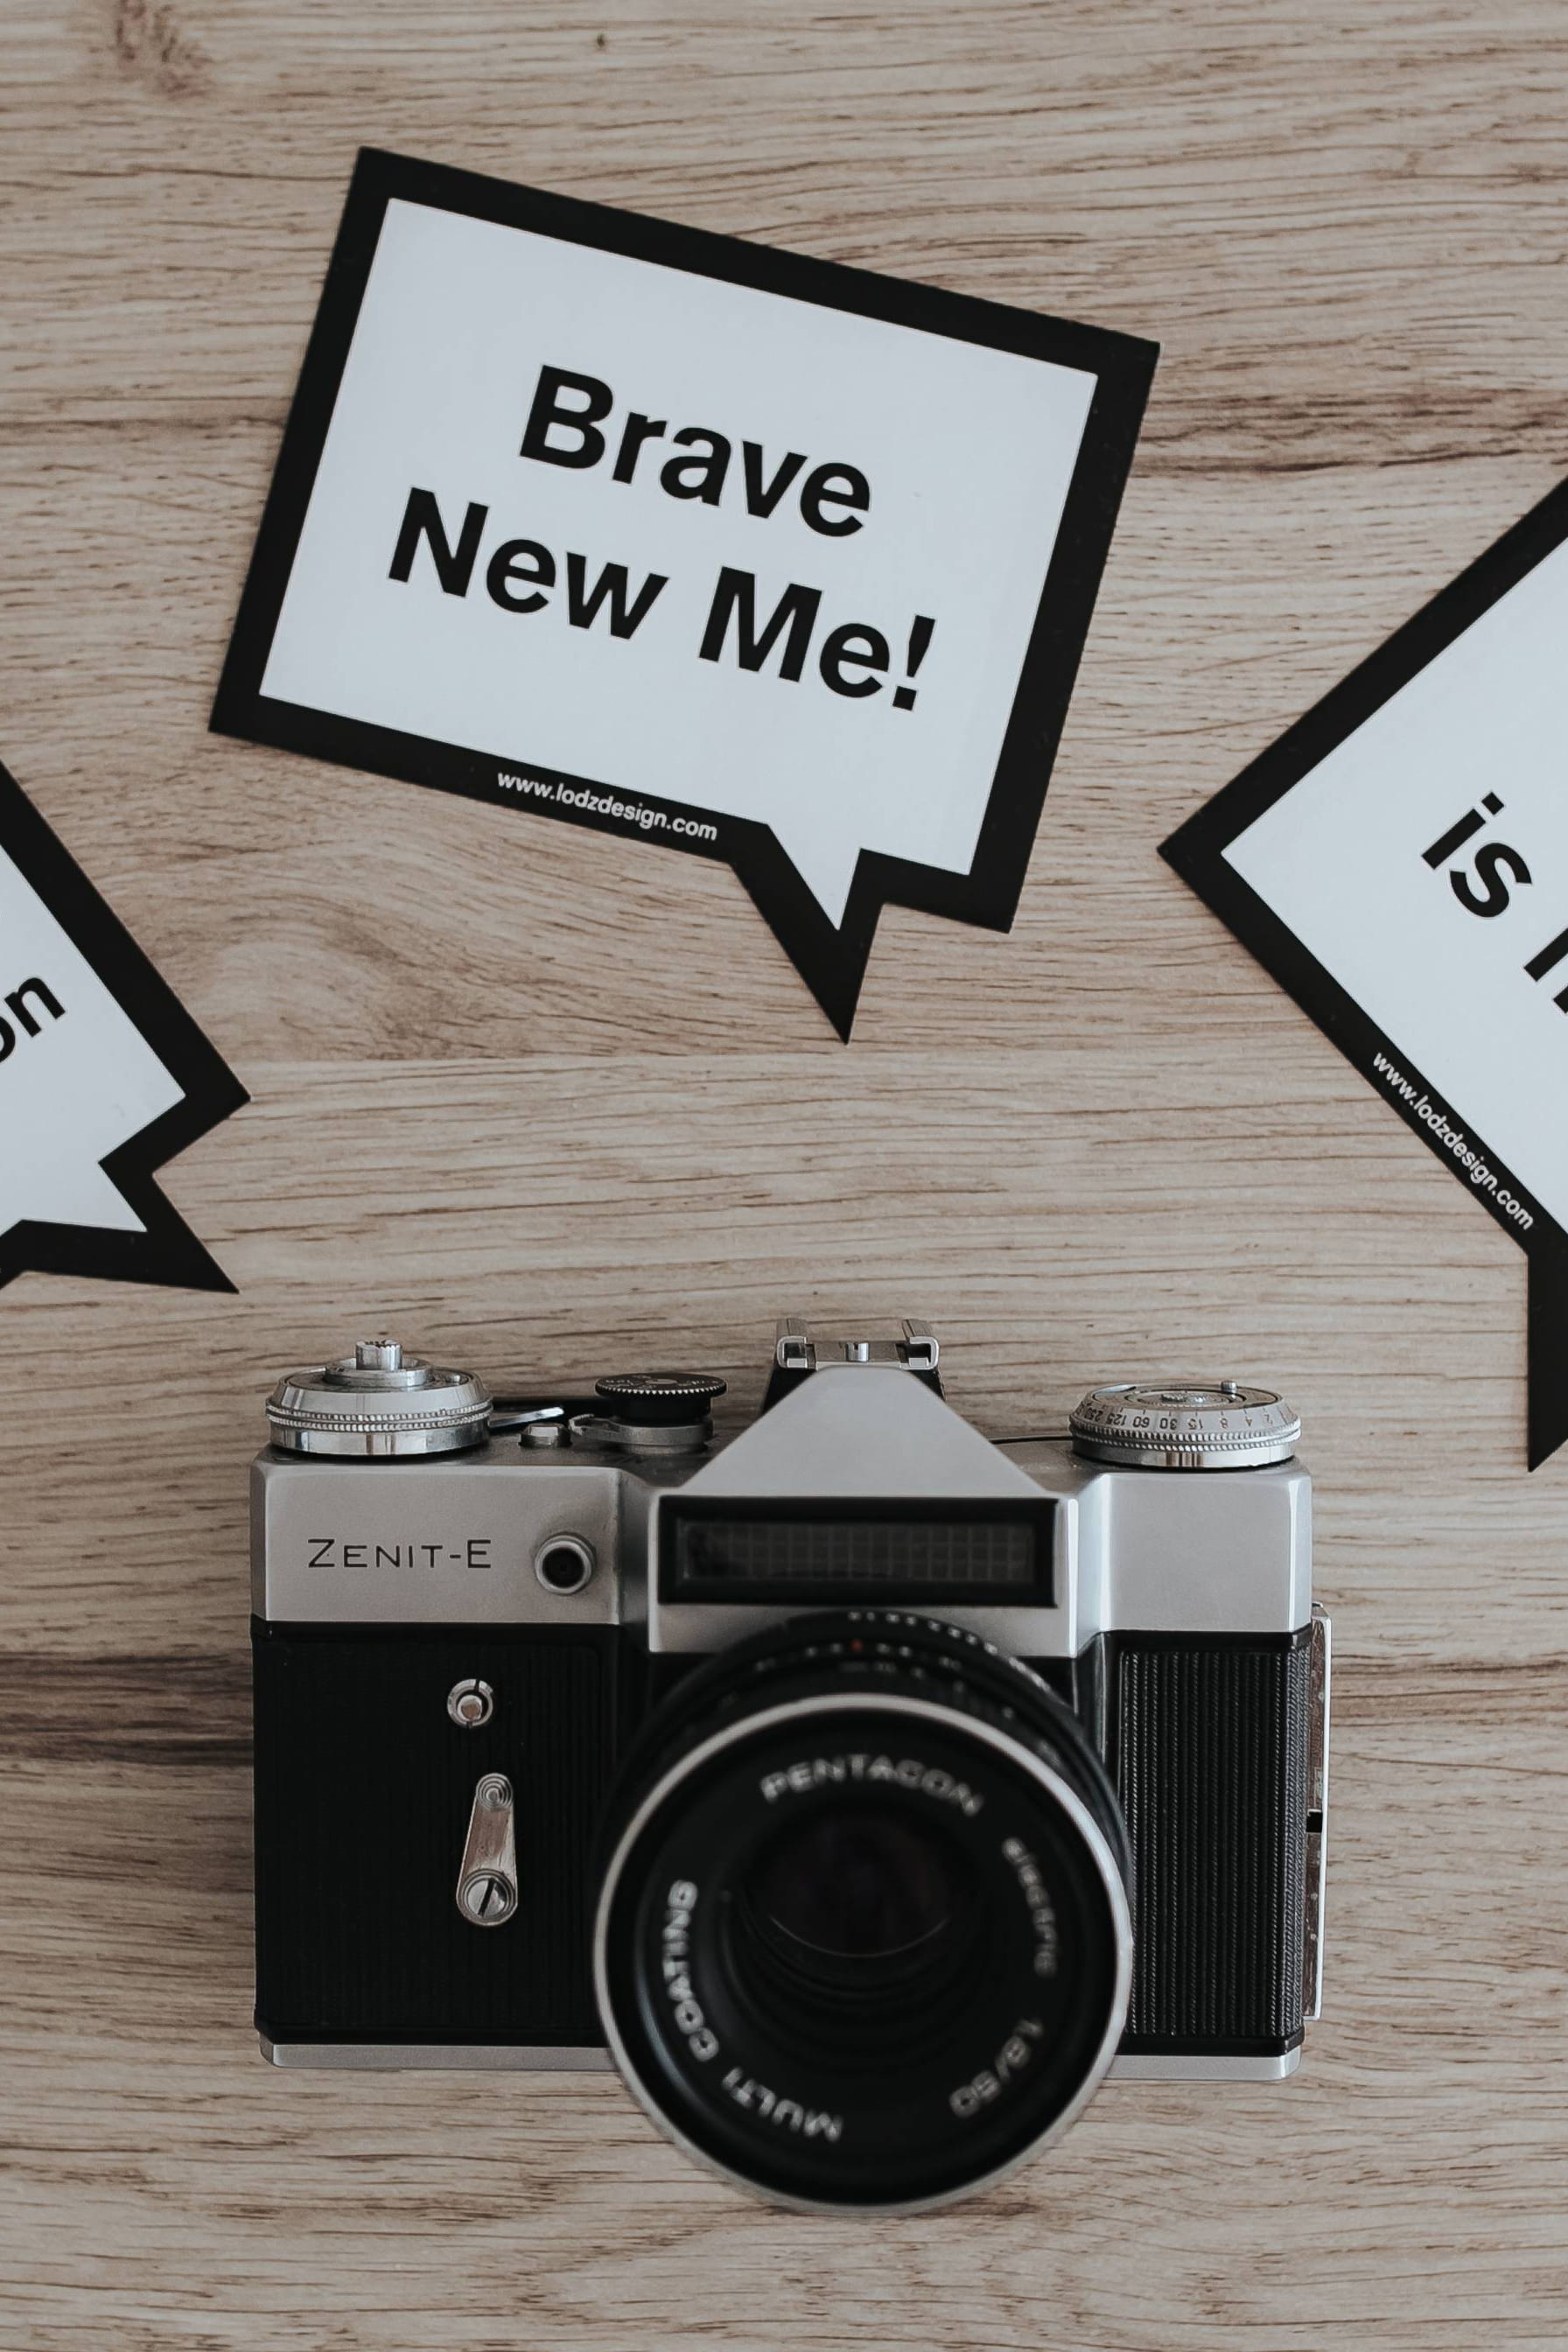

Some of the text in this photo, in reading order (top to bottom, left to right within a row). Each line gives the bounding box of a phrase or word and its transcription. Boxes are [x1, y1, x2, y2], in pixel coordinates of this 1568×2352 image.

[519, 364, 872, 537] Brave
[388, 486, 936, 711] New Me!
[497, 772, 718, 841] www.lodzdesign.com
[1421, 791, 1532, 918] is
[1373, 1052, 1534, 1230] www.lodzdesign.com
[1105, 1412, 1127, 1427] 125
[1132, 1415, 1150, 1429] 60
[1159, 1417, 1178, 1431] 30
[1188, 1418, 1203, 1431] 15
[307, 1538, 492, 1569] ZENIT-E
[662, 1879, 843, 2142] MULTI COATING
